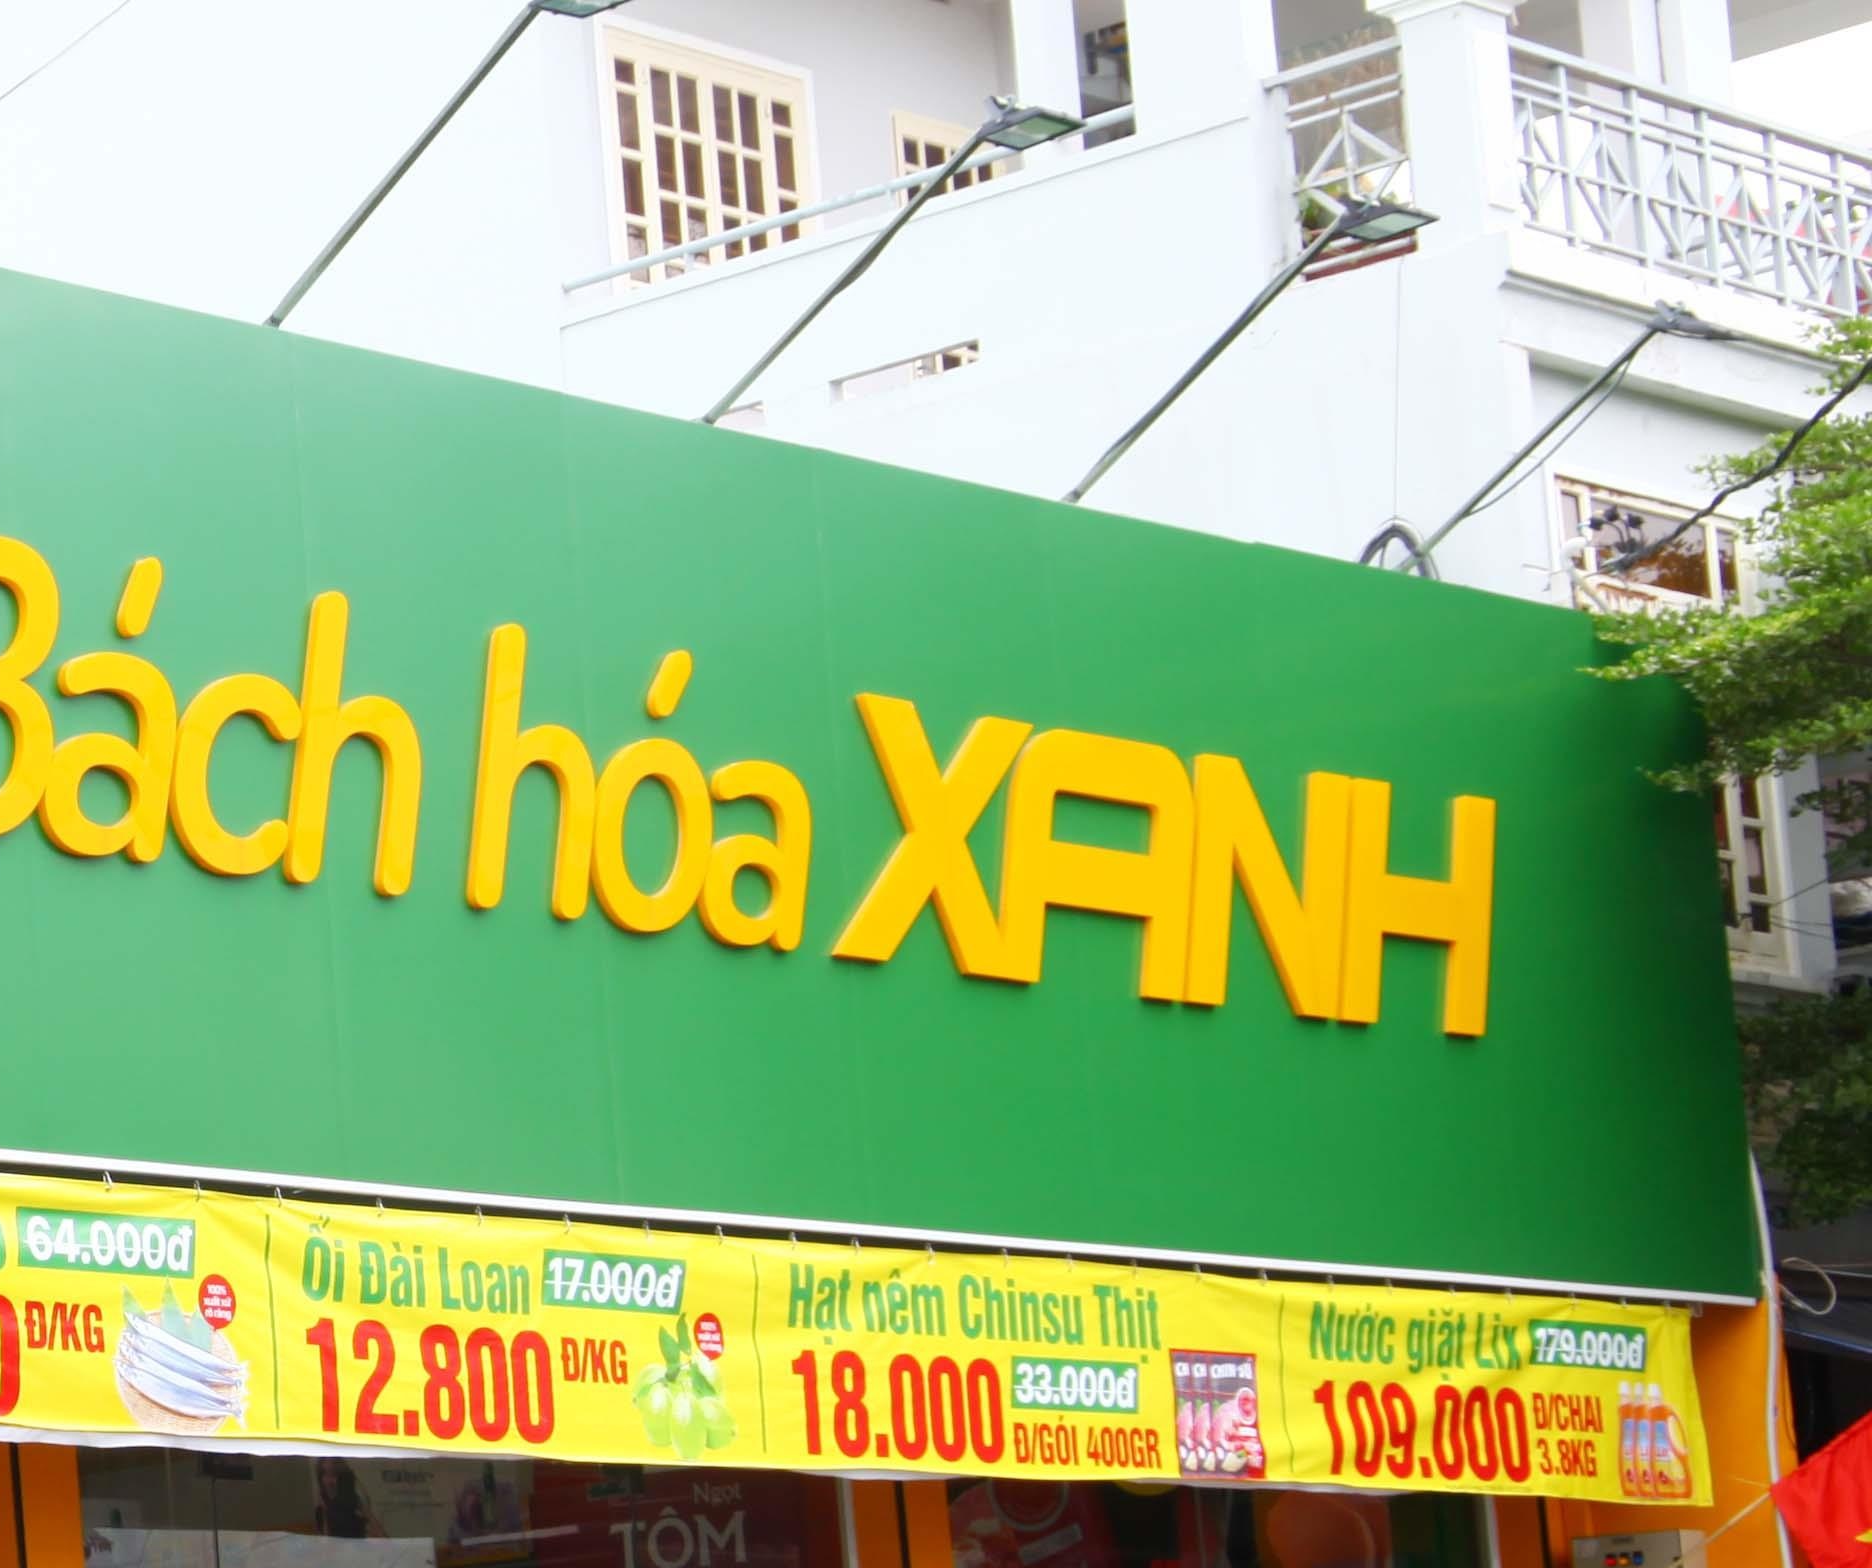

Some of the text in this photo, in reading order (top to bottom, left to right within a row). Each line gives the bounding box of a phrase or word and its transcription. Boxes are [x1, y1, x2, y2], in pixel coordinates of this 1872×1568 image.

[466, 622, 812, 952] hóa
[831, 691, 1497, 1038] XANH
[23, 1212, 195, 1276] 64.000đ
[301, 1213, 532, 1316] Ổi Đài Loan
[544, 1254, 684, 1312] 17.000đ
[787, 1264, 1162, 1365] Hạt nêm Chinsu Thịt
[23, 1301, 106, 1355] Đ/KG
[1309, 1301, 1522, 1382] Nước giặt Lix
[1533, 1326, 1646, 1370] 179.000đ
[305, 1317, 629, 1445] 12.800 Đ/KG
[791, 1347, 1004, 1465] 18.000
[1014, 1361, 1138, 1411] 33.000đ
[1532, 1393, 1604, 1433] Đ/CHAI
[1013, 1416, 1161, 1471] Đ/GÓI 400GR
[1313, 1379, 1532, 1482] 109.000
[1537, 1437, 1599, 1478] 3.8KG
